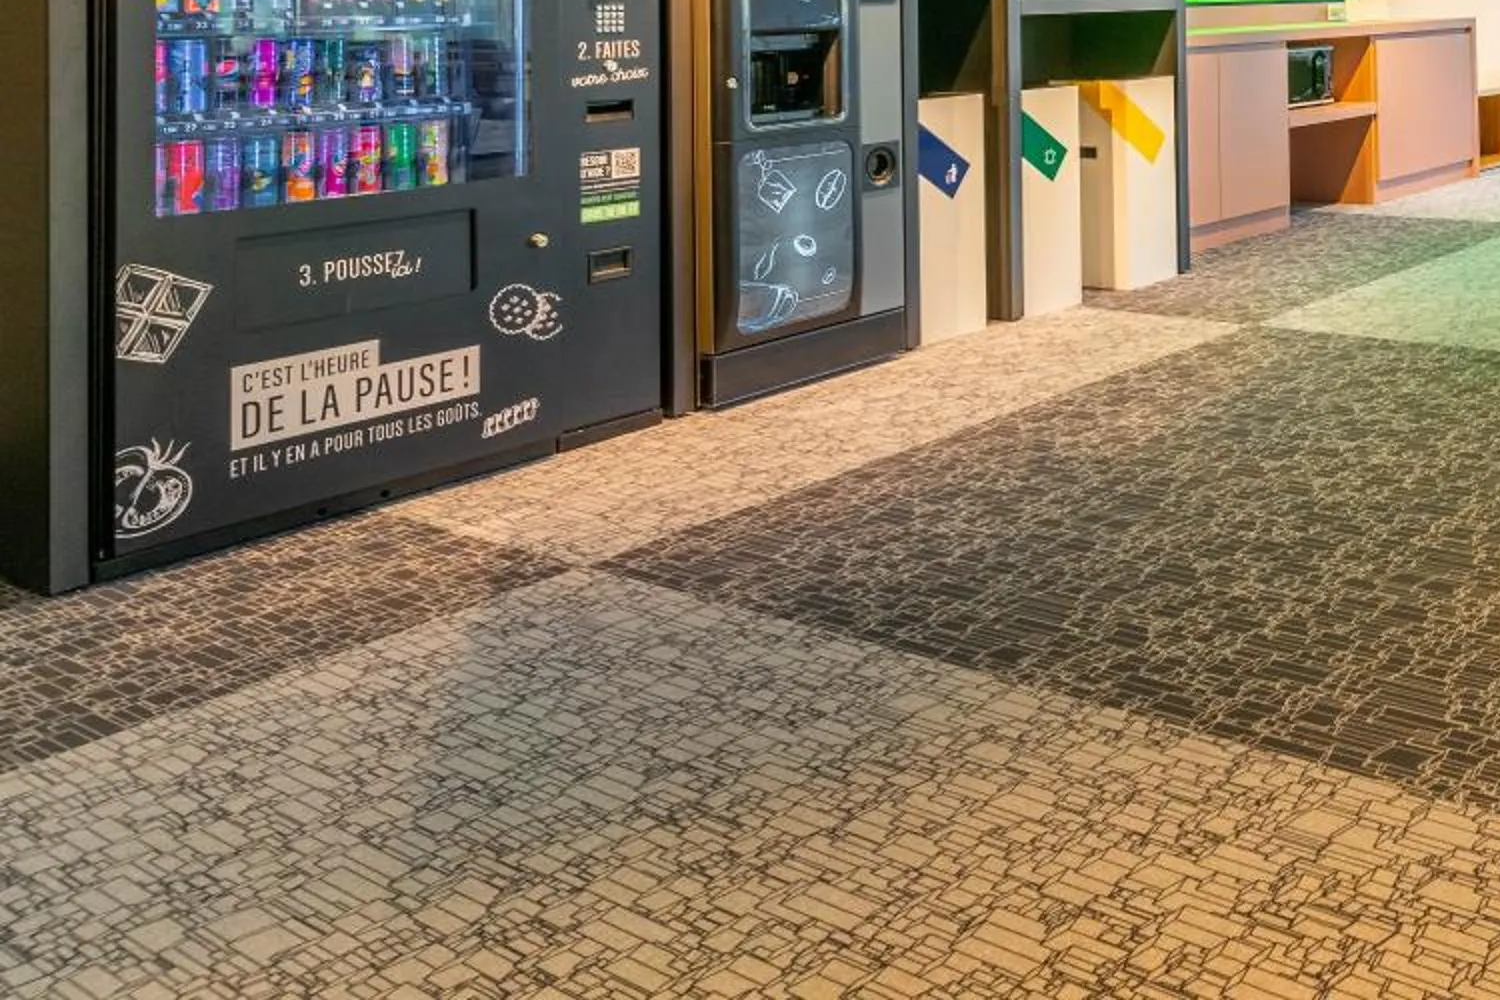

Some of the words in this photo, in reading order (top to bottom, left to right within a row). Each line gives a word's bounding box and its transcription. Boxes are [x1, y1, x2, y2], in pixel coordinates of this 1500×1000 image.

[577, 41, 592, 61] 2.
[595, 39, 641, 59] FAITES
[299, 264, 317, 287] 3.
[324, 249, 405, 283] POUSSEZ
[243, 367, 294, 394] C'EST
[301, 349, 370, 383] L'HEURE
[241, 395, 284, 440] DE
[301, 384, 340, 426] LA
[229, 456, 249, 480] ET
[253, 454, 267, 473] IL
[271, 449, 282, 467] Y
[286, 443, 305, 466] EN
[309, 440, 320, 460] A
[325, 431, 364, 457] POUR
[367, 420, 404, 446] TOUS
[408, 412, 434, 434] LES
